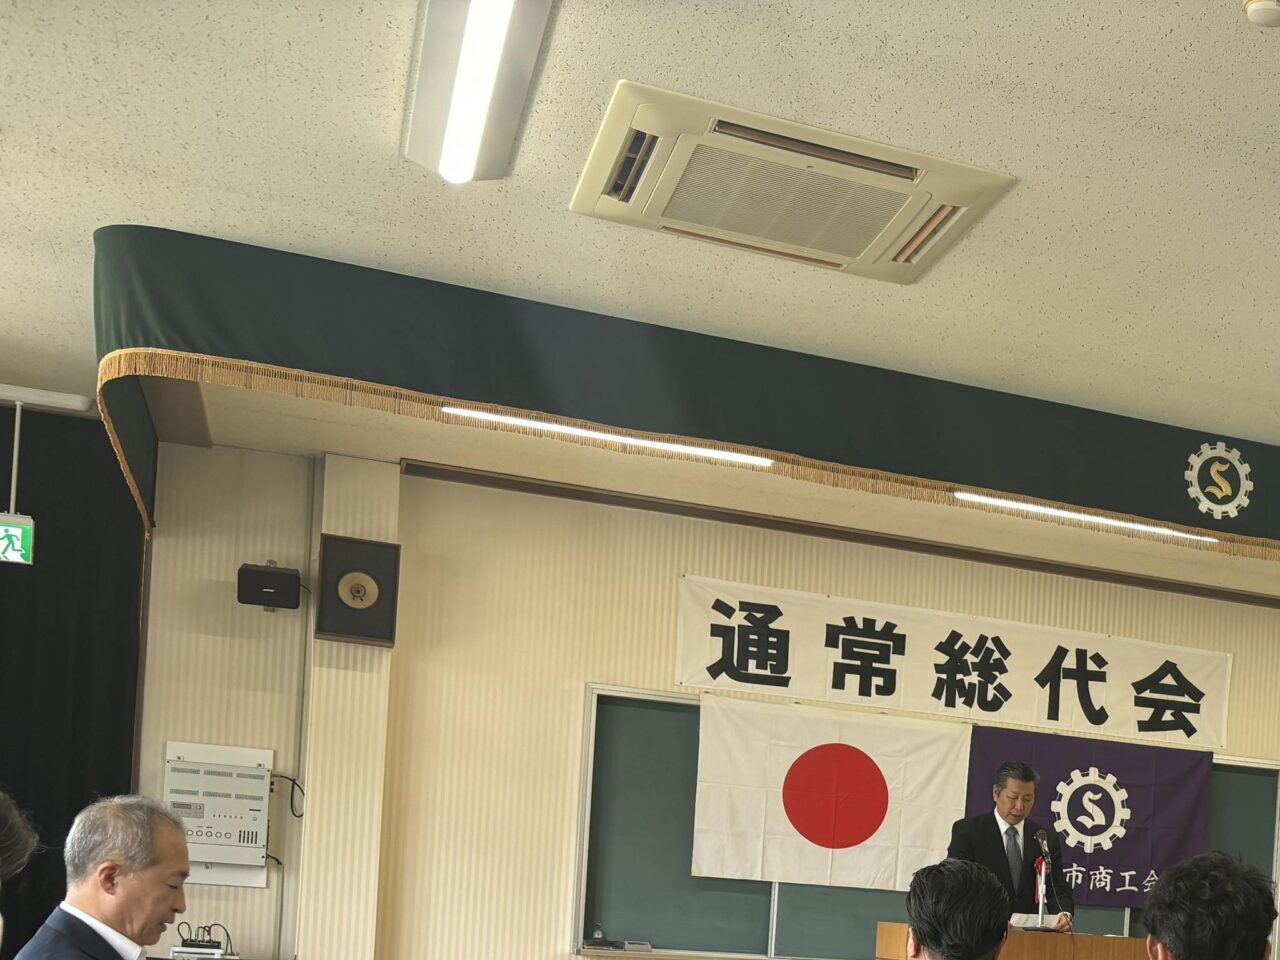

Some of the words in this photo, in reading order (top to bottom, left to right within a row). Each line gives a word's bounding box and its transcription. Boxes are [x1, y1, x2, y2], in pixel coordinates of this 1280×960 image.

[706, 598, 1206, 738] 通常総代会
